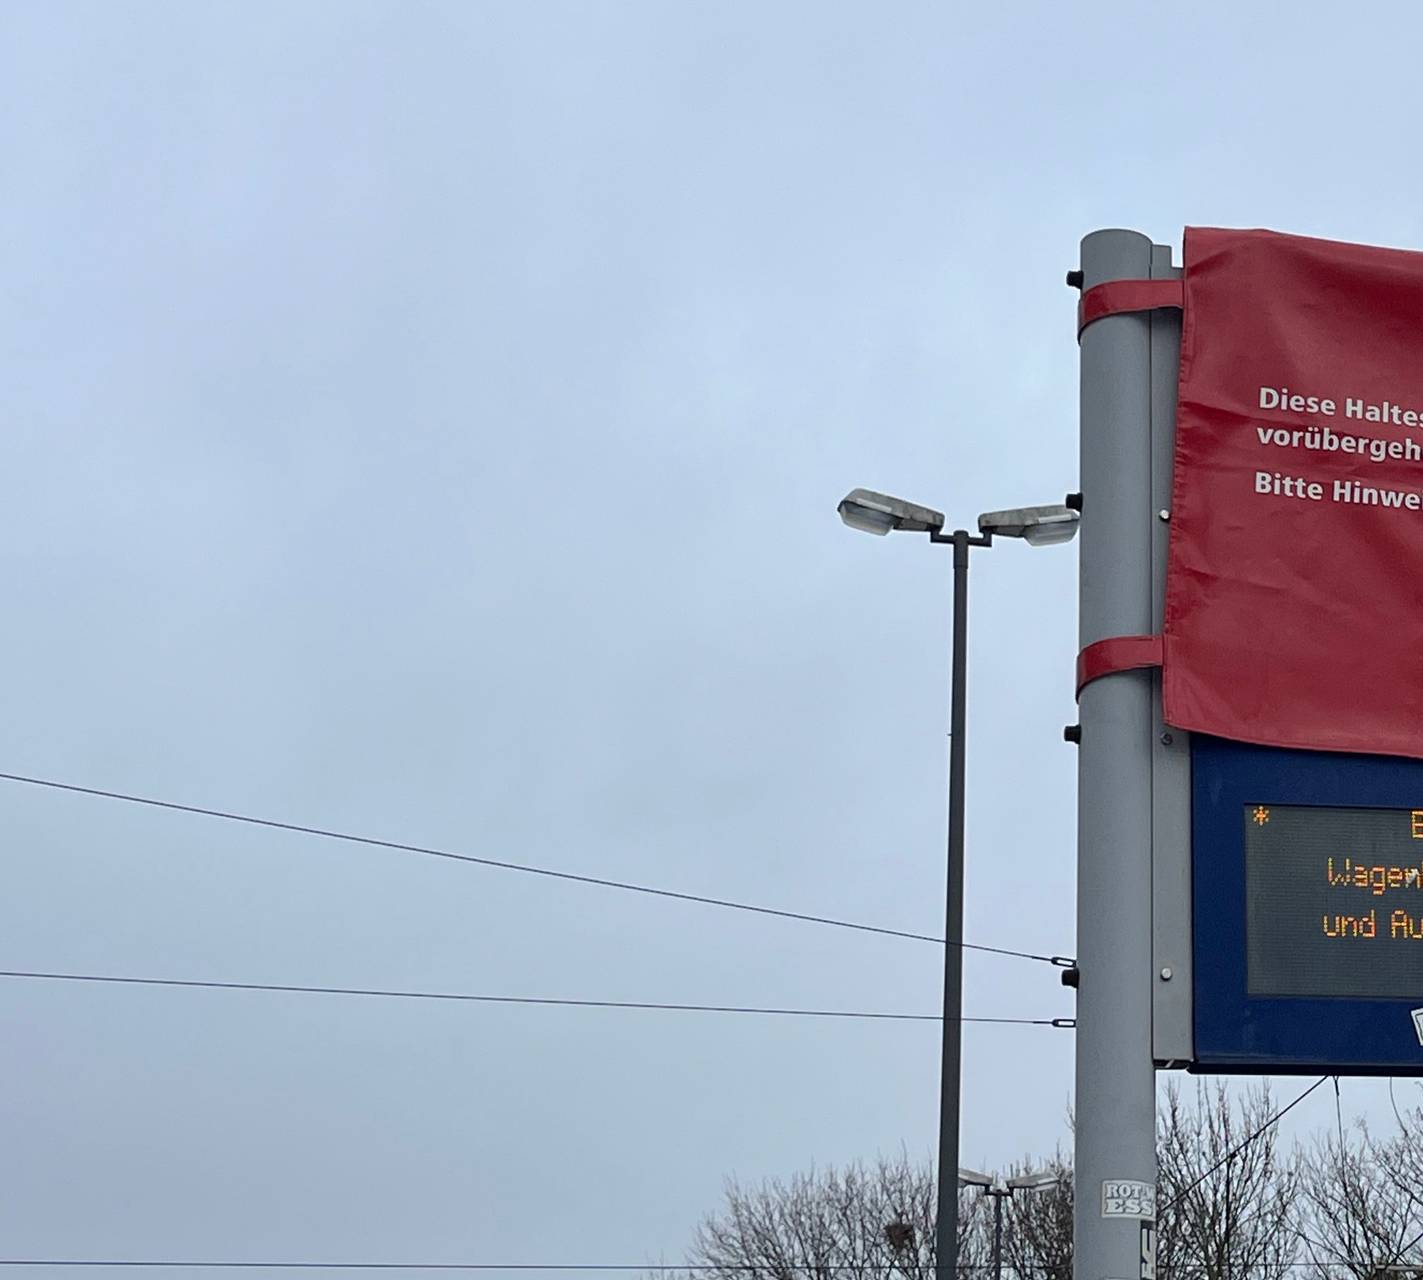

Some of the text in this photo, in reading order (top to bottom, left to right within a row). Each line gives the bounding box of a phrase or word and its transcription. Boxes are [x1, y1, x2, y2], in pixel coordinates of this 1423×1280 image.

[1258, 387, 1336, 416] Diese
[1255, 471, 1323, 500] Bitte
[1323, 910, 1377, 938] und
